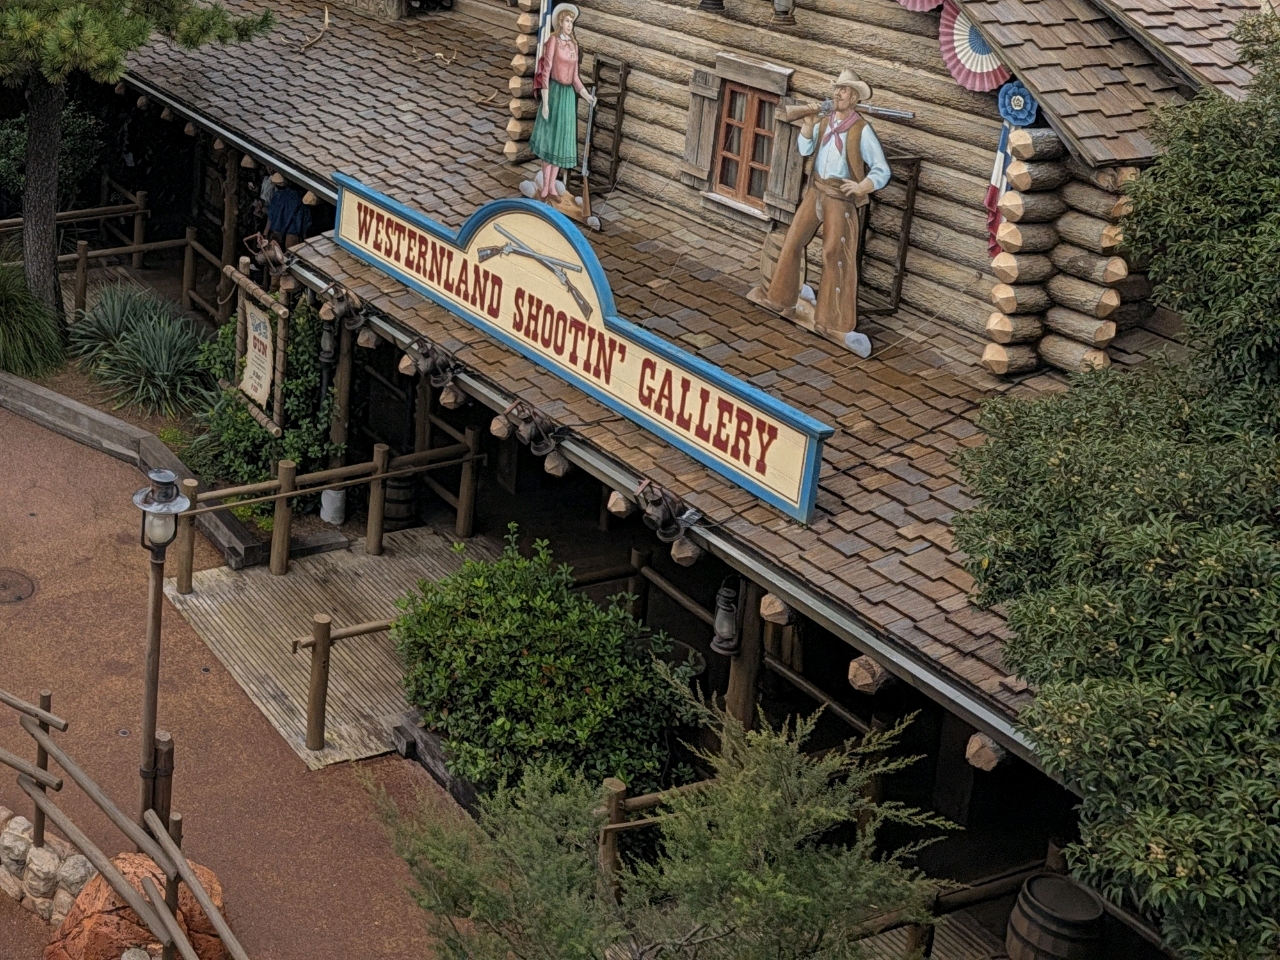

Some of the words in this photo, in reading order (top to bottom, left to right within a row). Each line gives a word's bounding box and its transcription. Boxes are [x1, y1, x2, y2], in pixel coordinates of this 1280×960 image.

[253, 334, 268, 357] GUN
[357, 201, 503, 318] WESTERNLAND
[512, 287, 627, 385] SHOOTIN'
[638, 357, 779, 476] GALLERY
